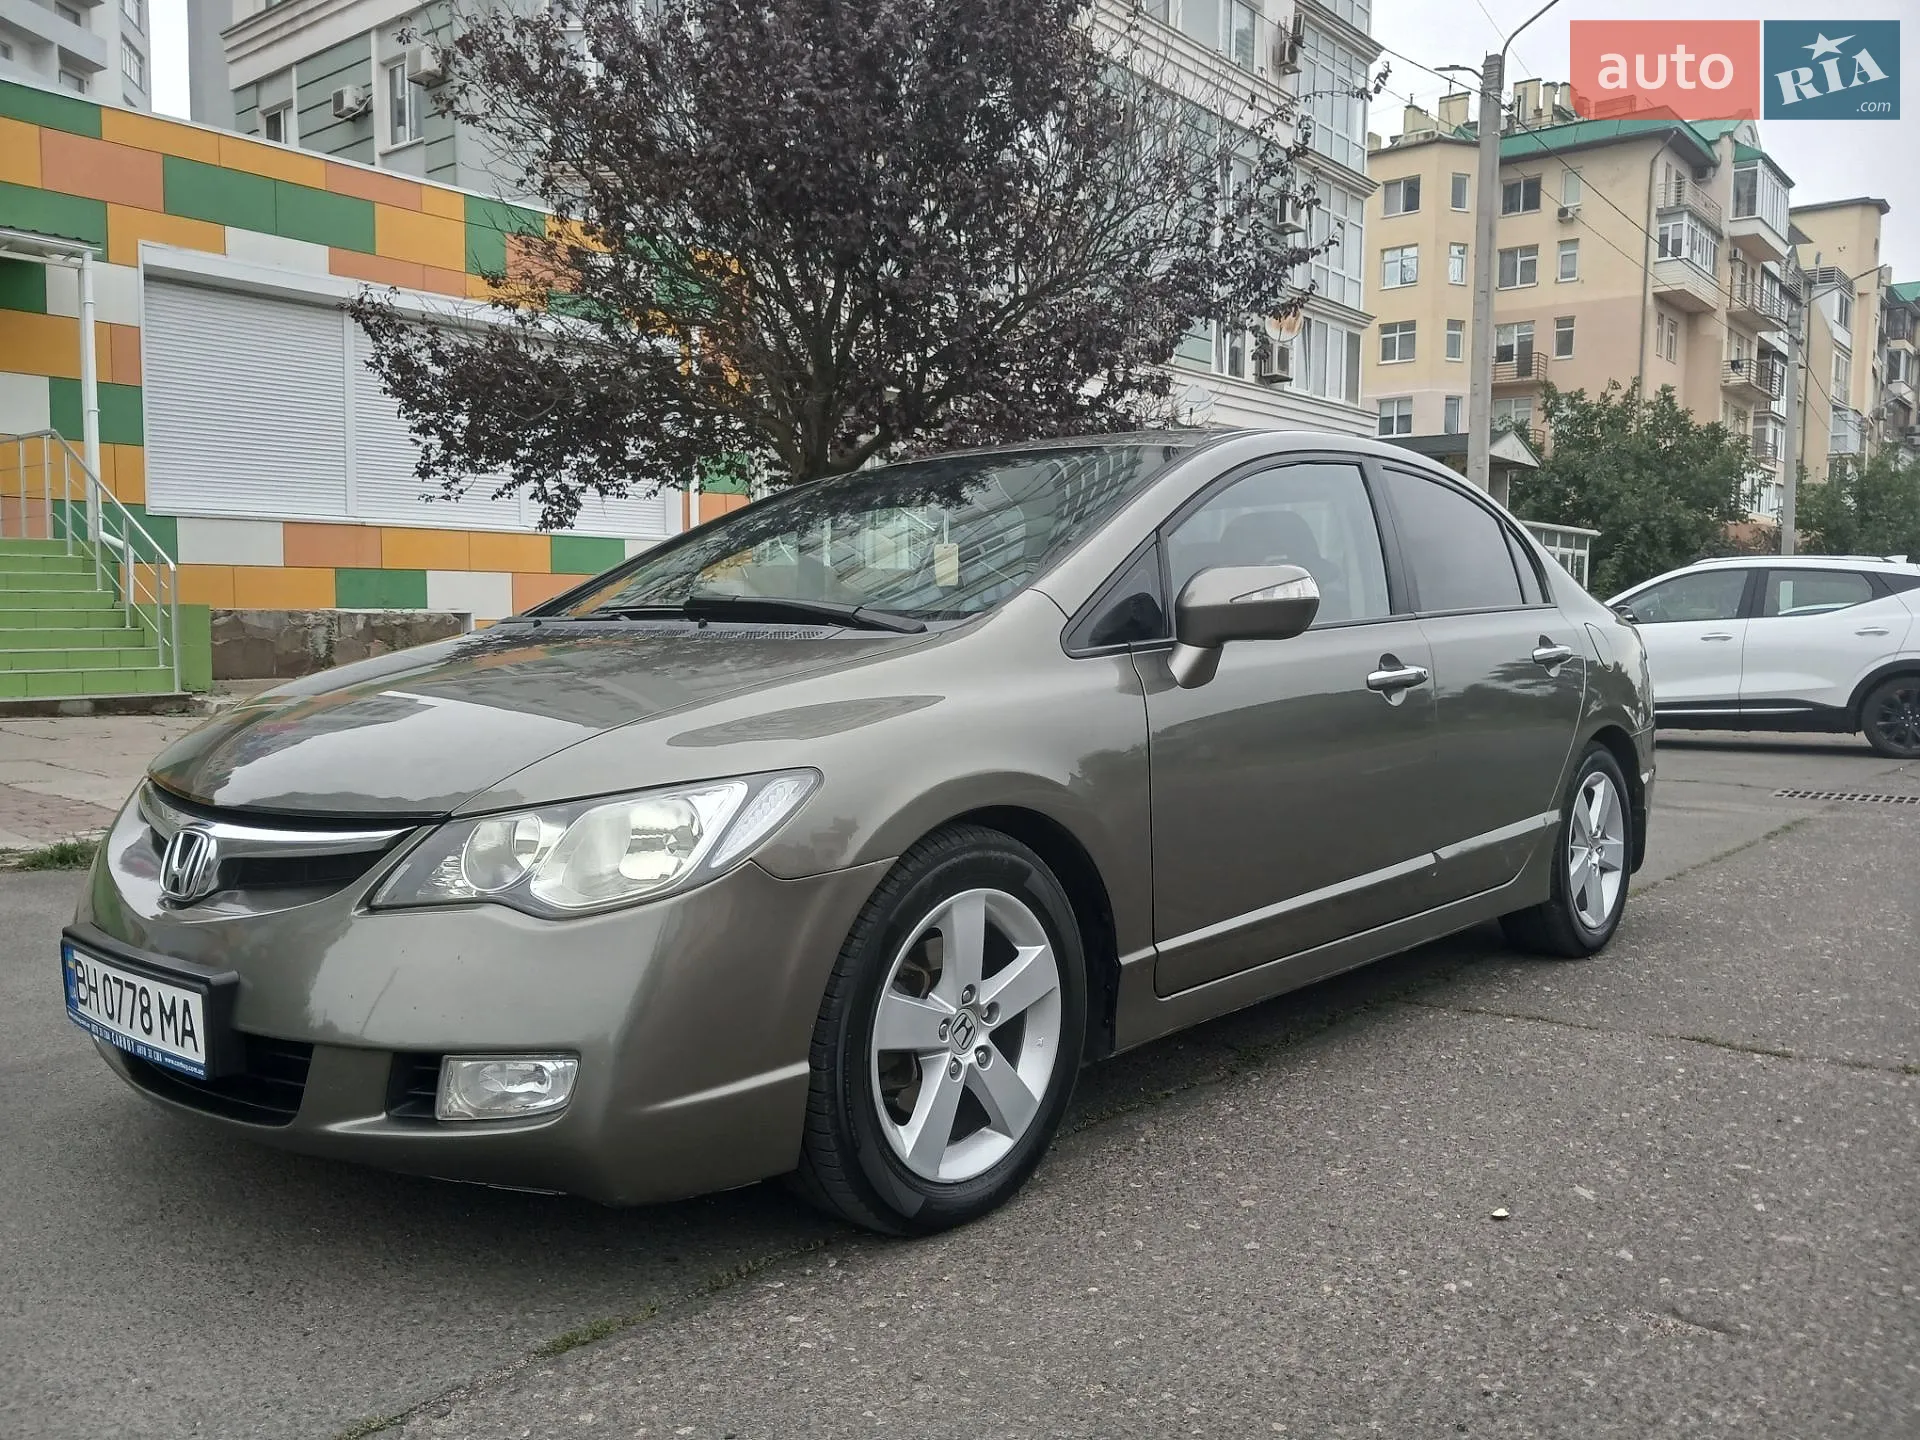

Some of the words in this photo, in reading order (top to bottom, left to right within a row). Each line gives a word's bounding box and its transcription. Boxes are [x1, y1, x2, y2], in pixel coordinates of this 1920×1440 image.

[74, 959, 100, 1015] BH
[102, 972, 154, 1036] 0778
[158, 991, 199, 1053] MA
